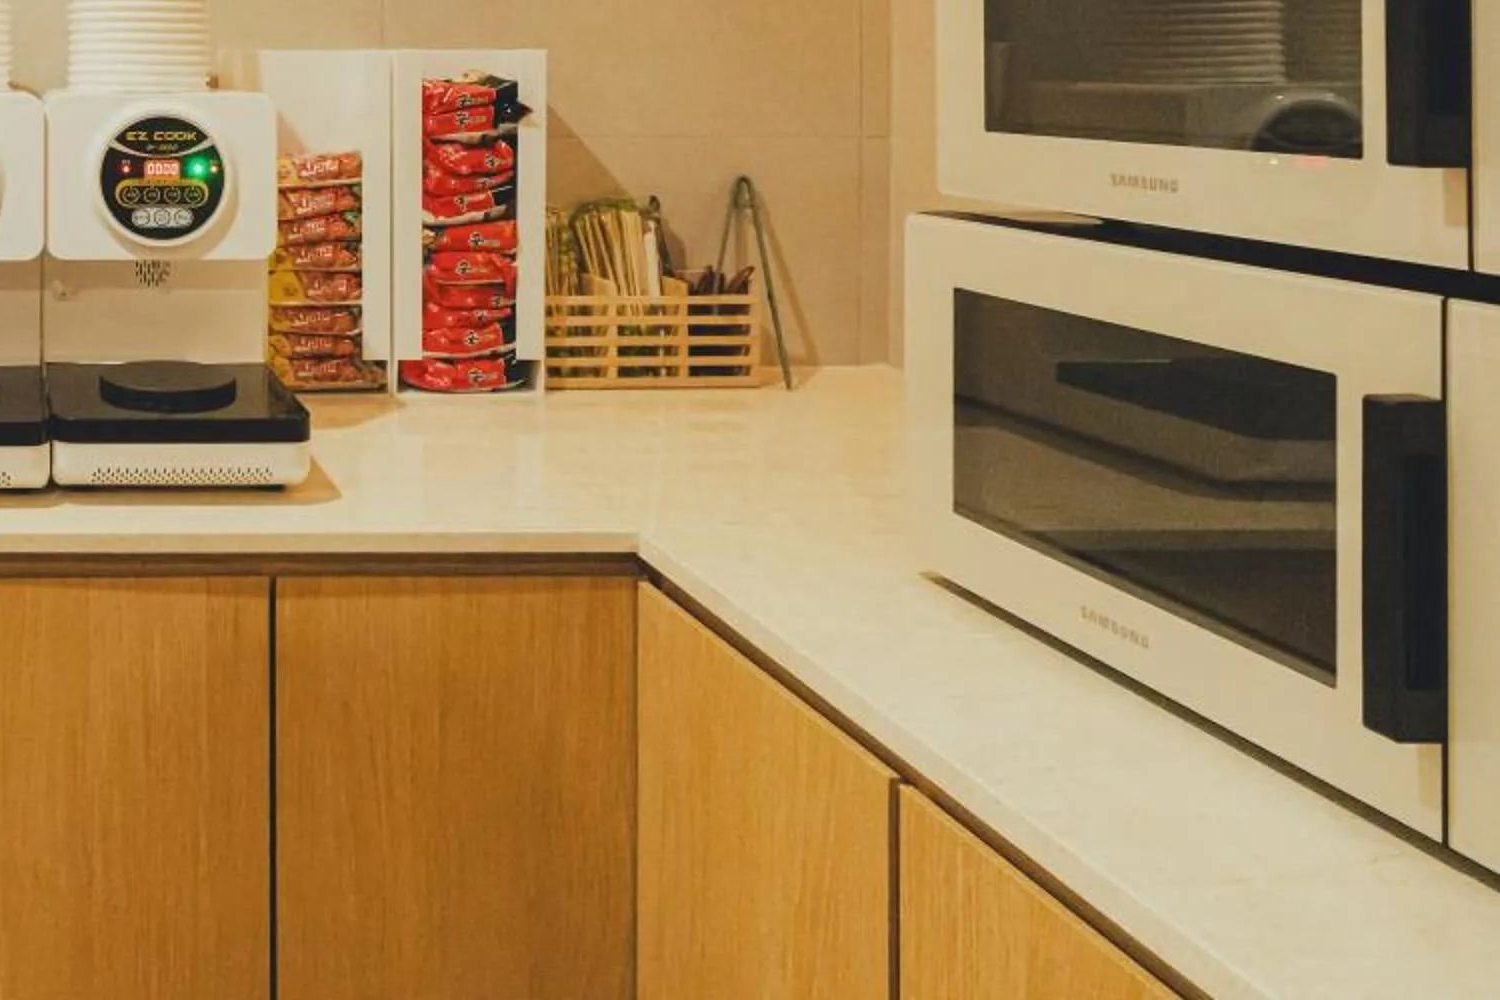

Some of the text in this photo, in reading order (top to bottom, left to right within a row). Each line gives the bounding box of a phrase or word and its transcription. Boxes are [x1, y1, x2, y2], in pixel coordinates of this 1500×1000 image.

[125, 131, 197, 141] EZ COOK
[1108, 173, 1180, 193] SAMSUNG
